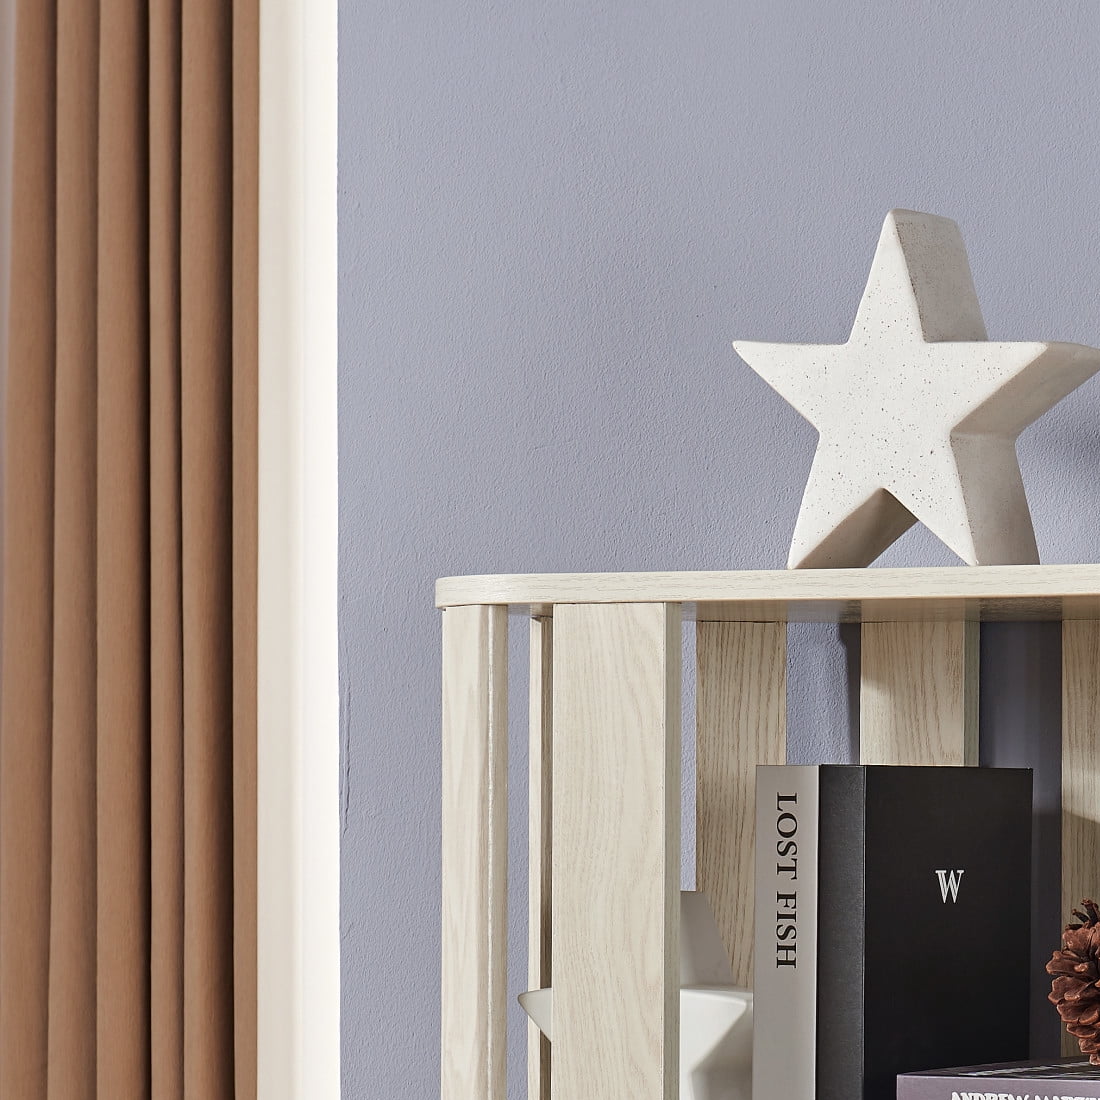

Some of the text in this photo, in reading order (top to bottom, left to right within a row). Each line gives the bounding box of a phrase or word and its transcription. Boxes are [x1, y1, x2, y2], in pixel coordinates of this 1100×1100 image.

[775, 792, 798, 969] LOST FISH
[935, 870, 964, 904] W
